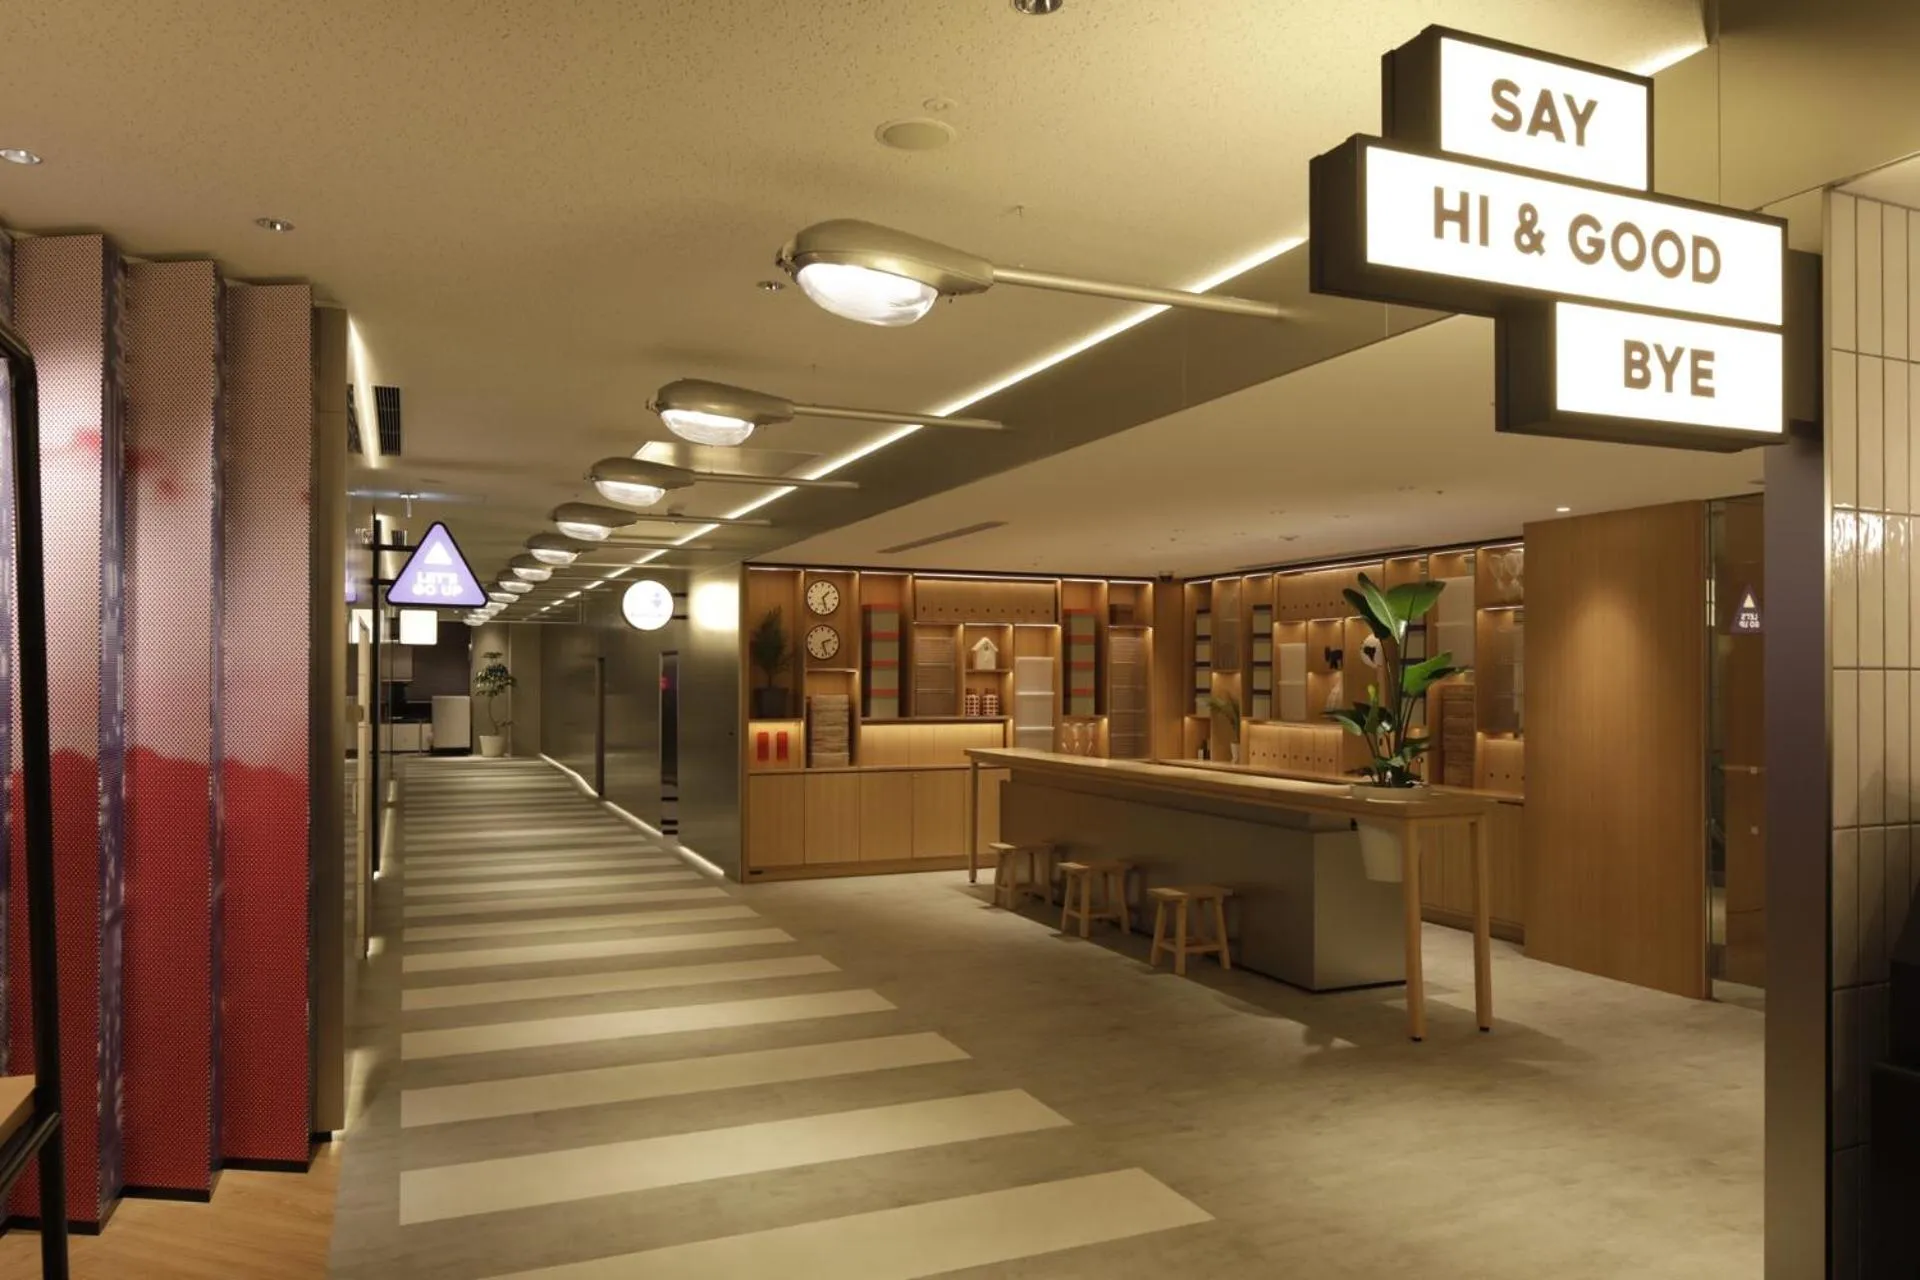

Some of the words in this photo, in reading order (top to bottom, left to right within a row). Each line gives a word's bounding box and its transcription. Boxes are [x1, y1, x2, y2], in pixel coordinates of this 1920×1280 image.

[1491, 78, 1598, 147] SAY
[1433, 186, 1489, 247] HI
[1514, 203, 1546, 256] &
[1568, 213, 1721, 284] GOOD
[1624, 340, 1715, 398] BYE
